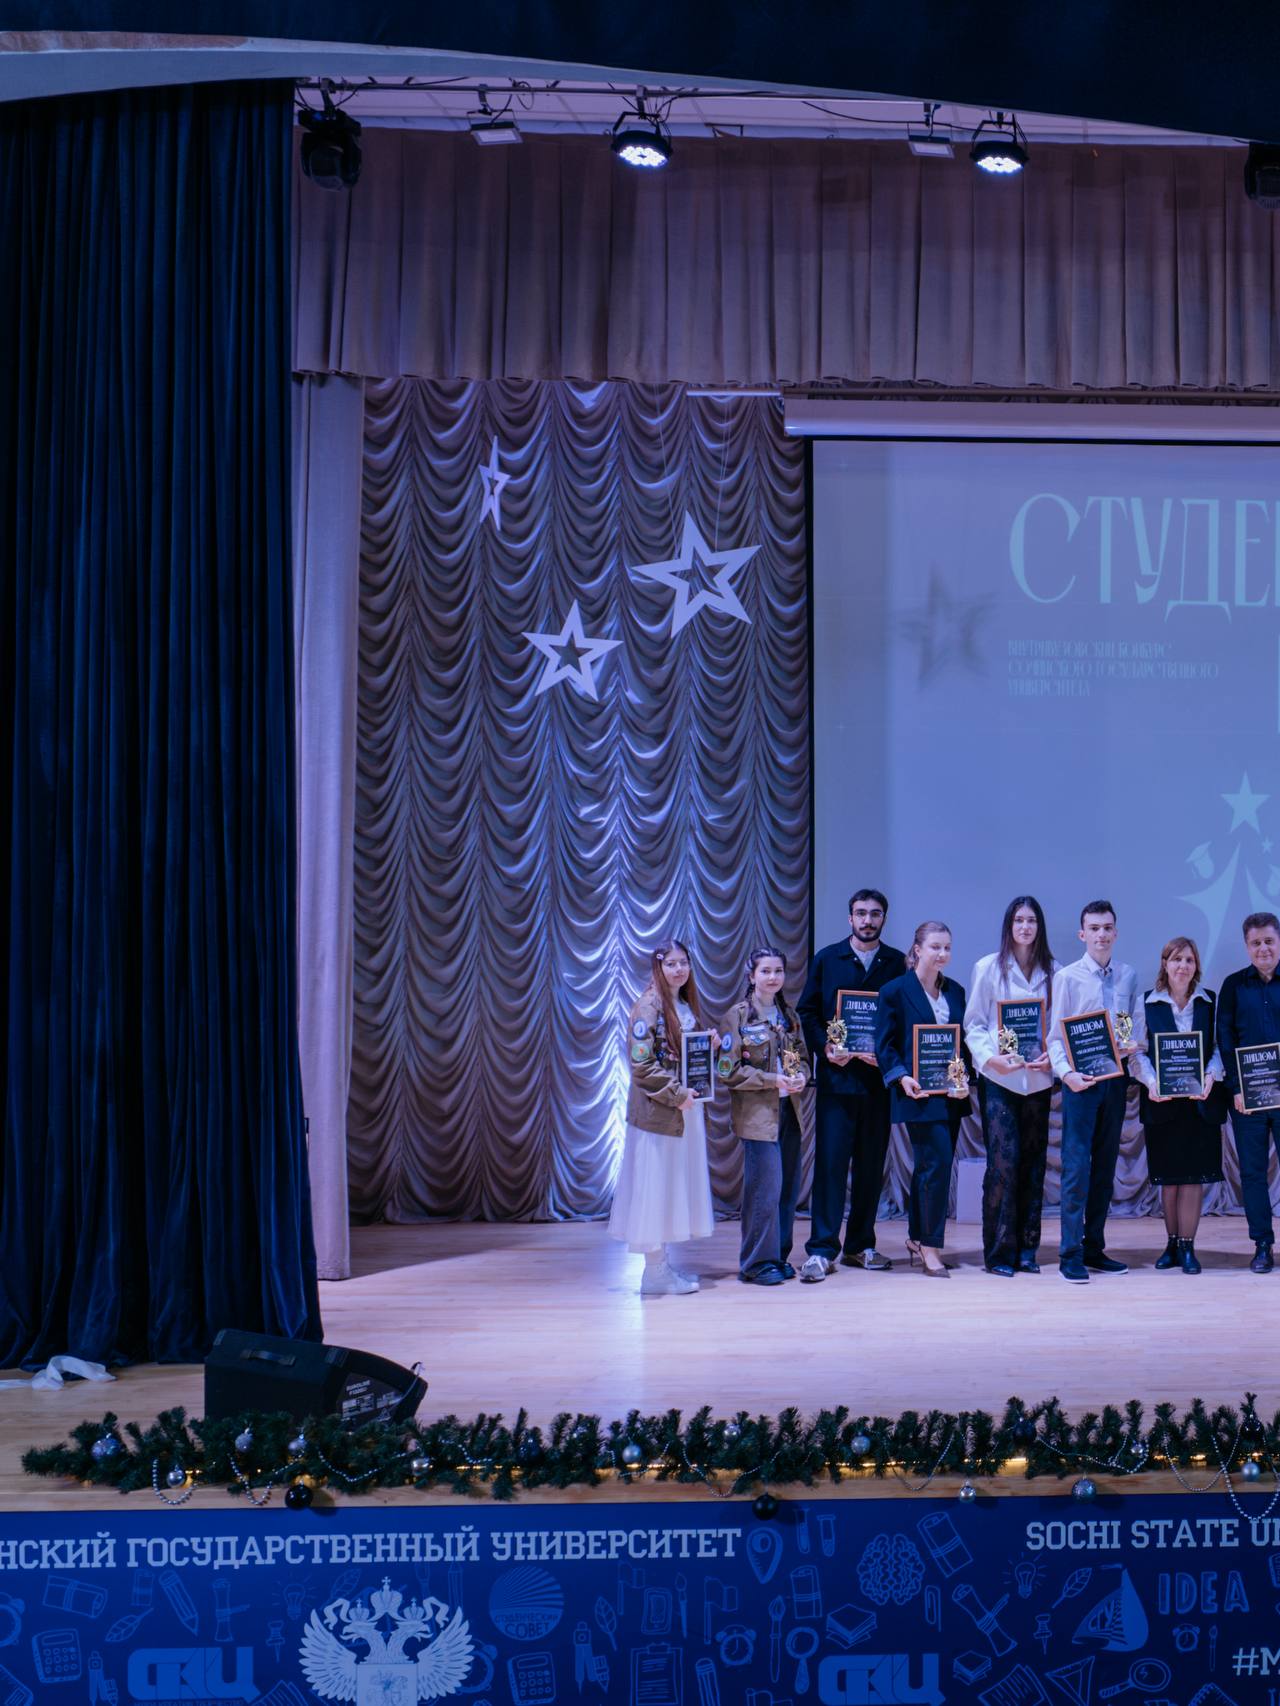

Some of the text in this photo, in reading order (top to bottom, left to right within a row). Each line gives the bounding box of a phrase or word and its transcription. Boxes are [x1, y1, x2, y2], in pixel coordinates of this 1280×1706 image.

[126, 1525, 481, 1570] ГОСУДАРСТВЕННЫЙ
[492, 1527, 742, 1560] УНИВЕРСИТЕТ
[1025, 1520, 1121, 1550] SOCHI
[1130, 1518, 1240, 1549] STATE
[1158, 1570, 1250, 1615] IDEA
